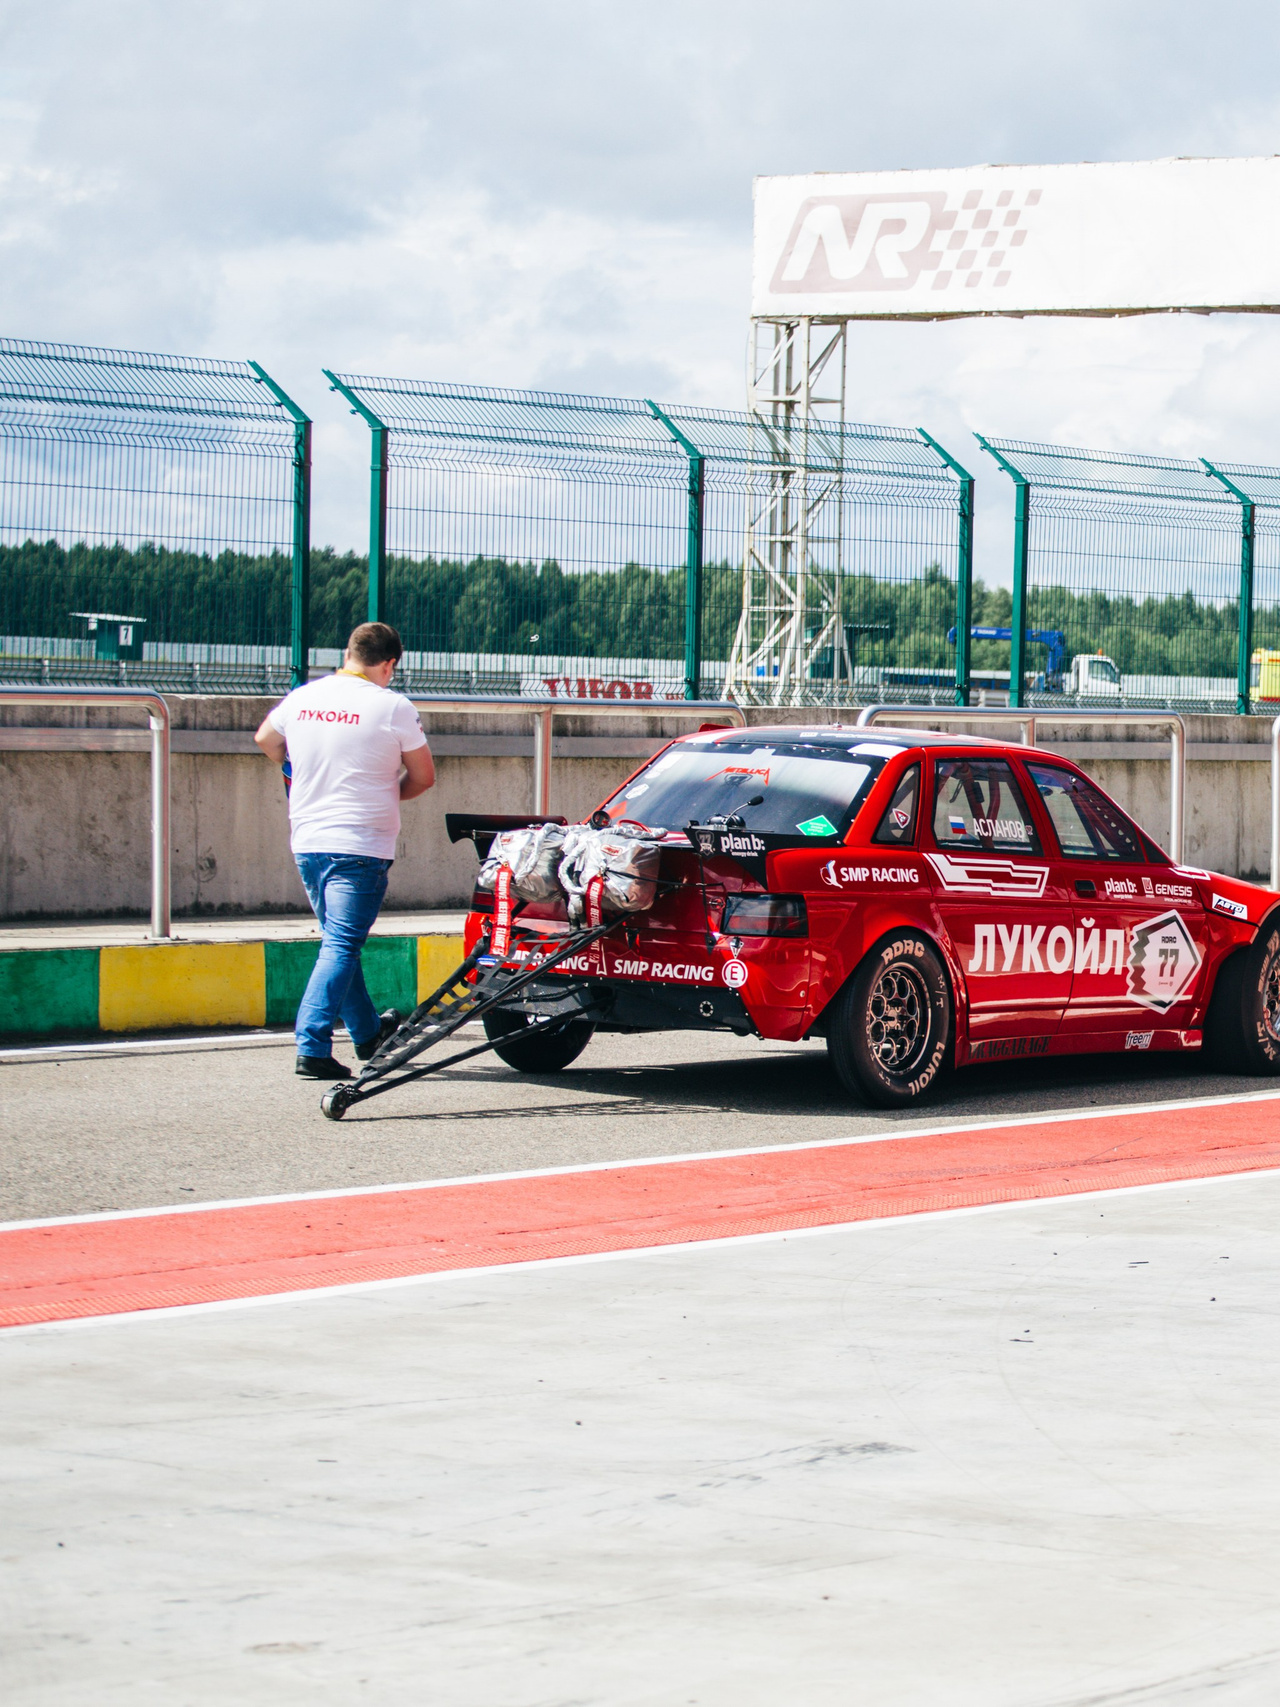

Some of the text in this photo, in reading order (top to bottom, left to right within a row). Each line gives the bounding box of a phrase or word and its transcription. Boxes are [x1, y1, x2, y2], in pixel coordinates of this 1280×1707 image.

[781, 200, 932, 282] NR
[123, 627, 130, 640] 7
[297, 709, 360, 725] ЛУКОЙЛ
[973, 818, 1025, 840] АСЛАНОВ
[721, 833, 751, 853] plan
[840, 867, 919, 883] SMP RACING
[1104, 877, 1127, 896] plan
[1155, 883, 1193, 897] GENESIS
[881, 939, 925, 966] RDRC
[968, 916, 1125, 976] ЛУКОЙЛ
[613, 959, 714, 982] SMP RACING
[730, 965, 739, 981] E
[1158, 948, 1180, 978] 77
[908, 1041, 946, 1097] LUKOIL
